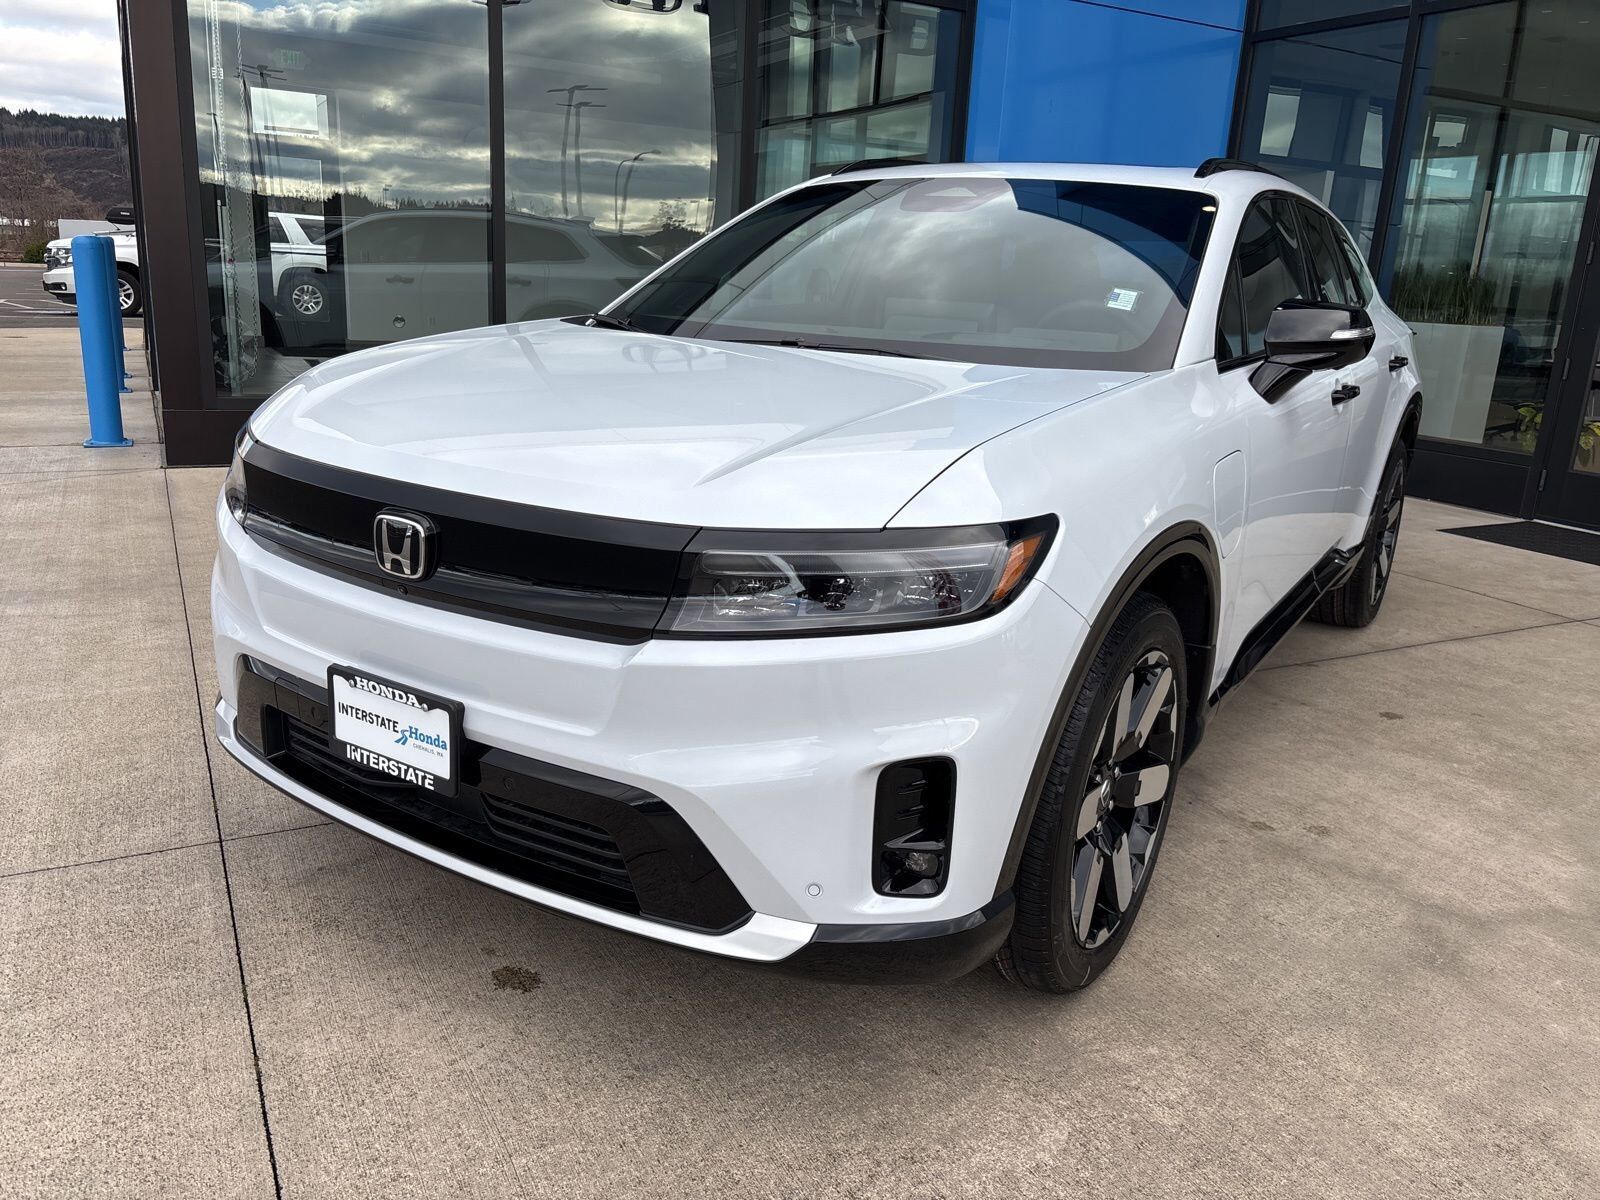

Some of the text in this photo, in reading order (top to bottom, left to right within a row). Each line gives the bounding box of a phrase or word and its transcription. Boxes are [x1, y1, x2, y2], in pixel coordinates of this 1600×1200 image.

[354, 676, 421, 709] HONDA
[338, 702, 399, 733] INTERSTATE
[408, 725, 448, 750] Honda
[346, 744, 435, 790] INTERSTATE
